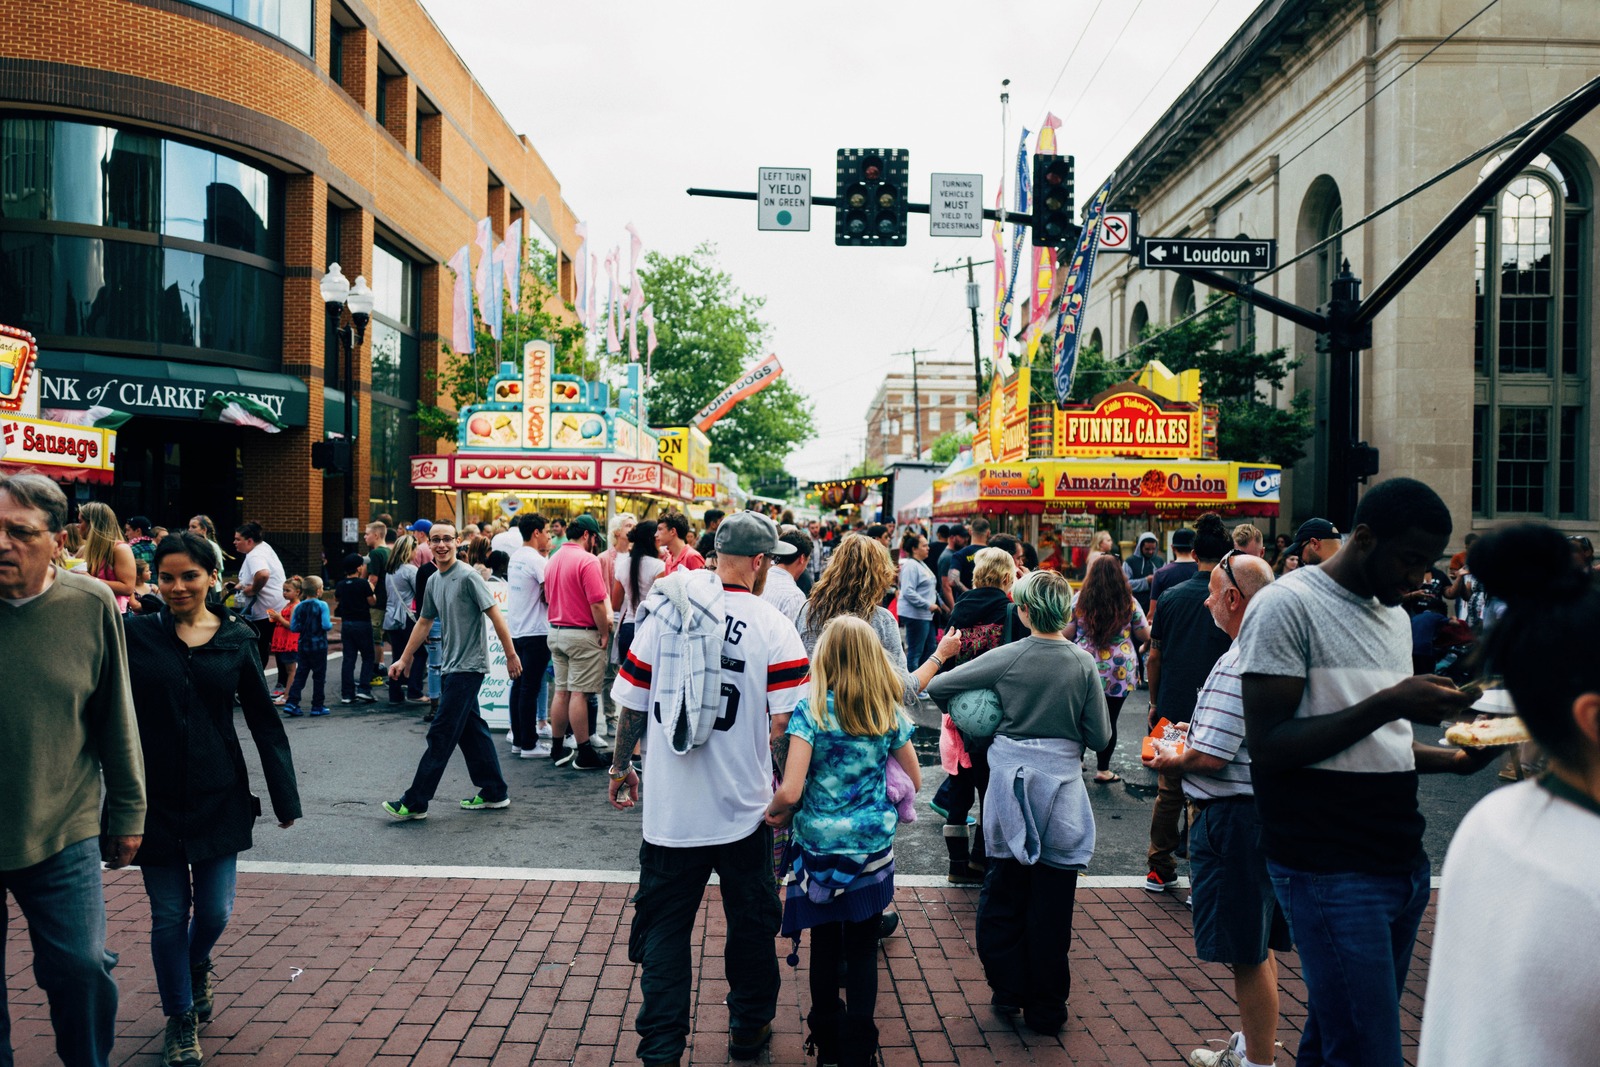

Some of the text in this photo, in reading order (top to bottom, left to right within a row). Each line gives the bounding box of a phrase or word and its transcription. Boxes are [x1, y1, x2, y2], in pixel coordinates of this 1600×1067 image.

[763, 172, 806, 181] LEFT TURN
[769, 184, 802, 195] YIELD
[942, 180, 972, 188] TURNING
[940, 190, 974, 198] VEHICLES
[763, 197, 805, 207] ON GREEN
[944, 200, 969, 210] MUST
[941, 212, 973, 220] YIELD TO
[932, 221, 979, 230] PEDESTRIANS
[1172, 245, 1266, 263] N Loudoun ST
[736, 365, 772, 390] DOGS
[86, 379, 118, 406] of
[119, 383, 206, 410] CLARKE
[1068, 417, 1188, 445] FUNNEL CAKES
[23, 425, 98, 463] Sausage
[459, 464, 590, 481] POPCORN
[989, 469, 1022, 479] Pickles
[1239, 470, 1264, 481] FRIED
[1057, 472, 1226, 494] Amazing Onion
[1046, 501, 1087, 509] FUNNEL
[1095, 501, 1130, 509] CAKES
[1155, 502, 1188, 510] GIANT
[480, 687, 505, 698] Food
